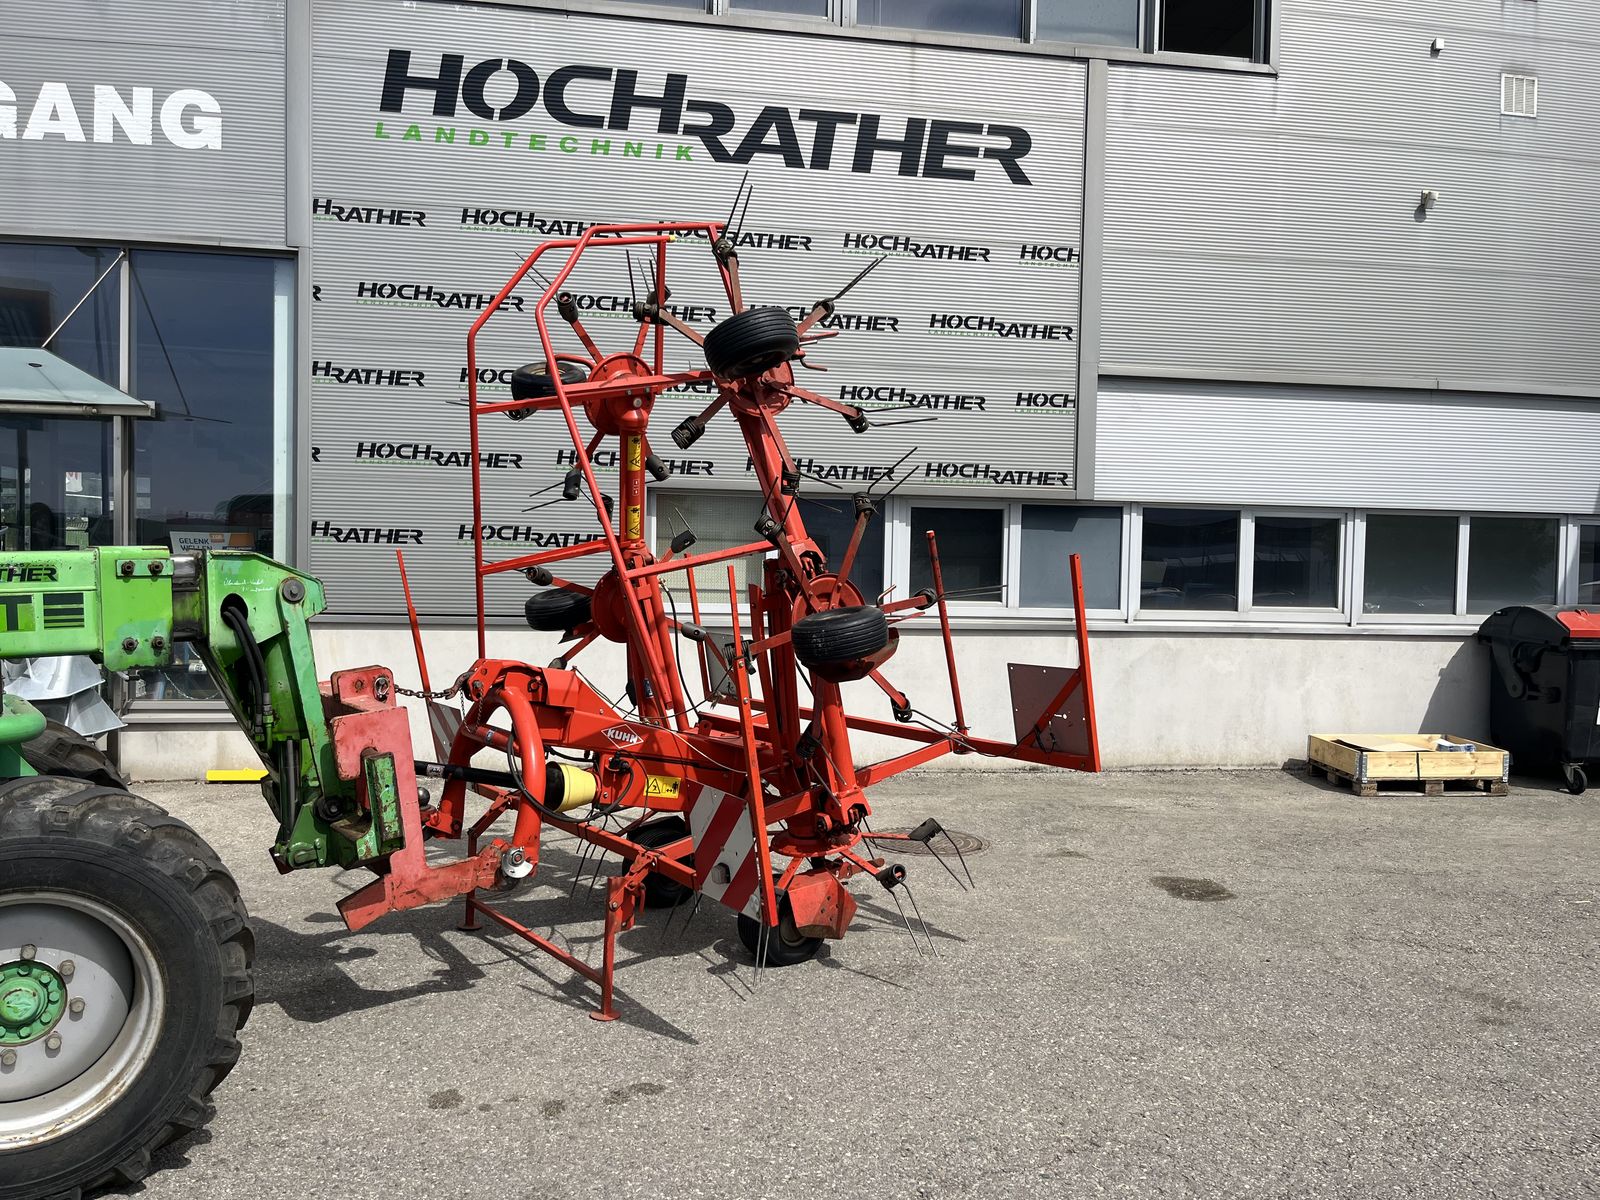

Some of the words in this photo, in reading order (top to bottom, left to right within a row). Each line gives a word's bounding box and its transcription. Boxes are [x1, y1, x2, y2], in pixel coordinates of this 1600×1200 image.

[0, 80, 222, 150] ANG
[380, 48, 1033, 185] HOCHRATHER
[375, 121, 694, 162] LANDTECHNIK
[843, 232, 990, 262] HOCHRATHER
[357, 282, 525, 312] HOCHRATHER
[929, 313, 1074, 341] HOCHRATHER
[839, 385, 986, 411] HOCHRATHER
[356, 442, 523, 469] HOCHRATHER
[925, 462, 1068, 486] HOCHRATHER
[178, 537, 210, 545] GELENK
[607, 729, 638, 744] KUHN
